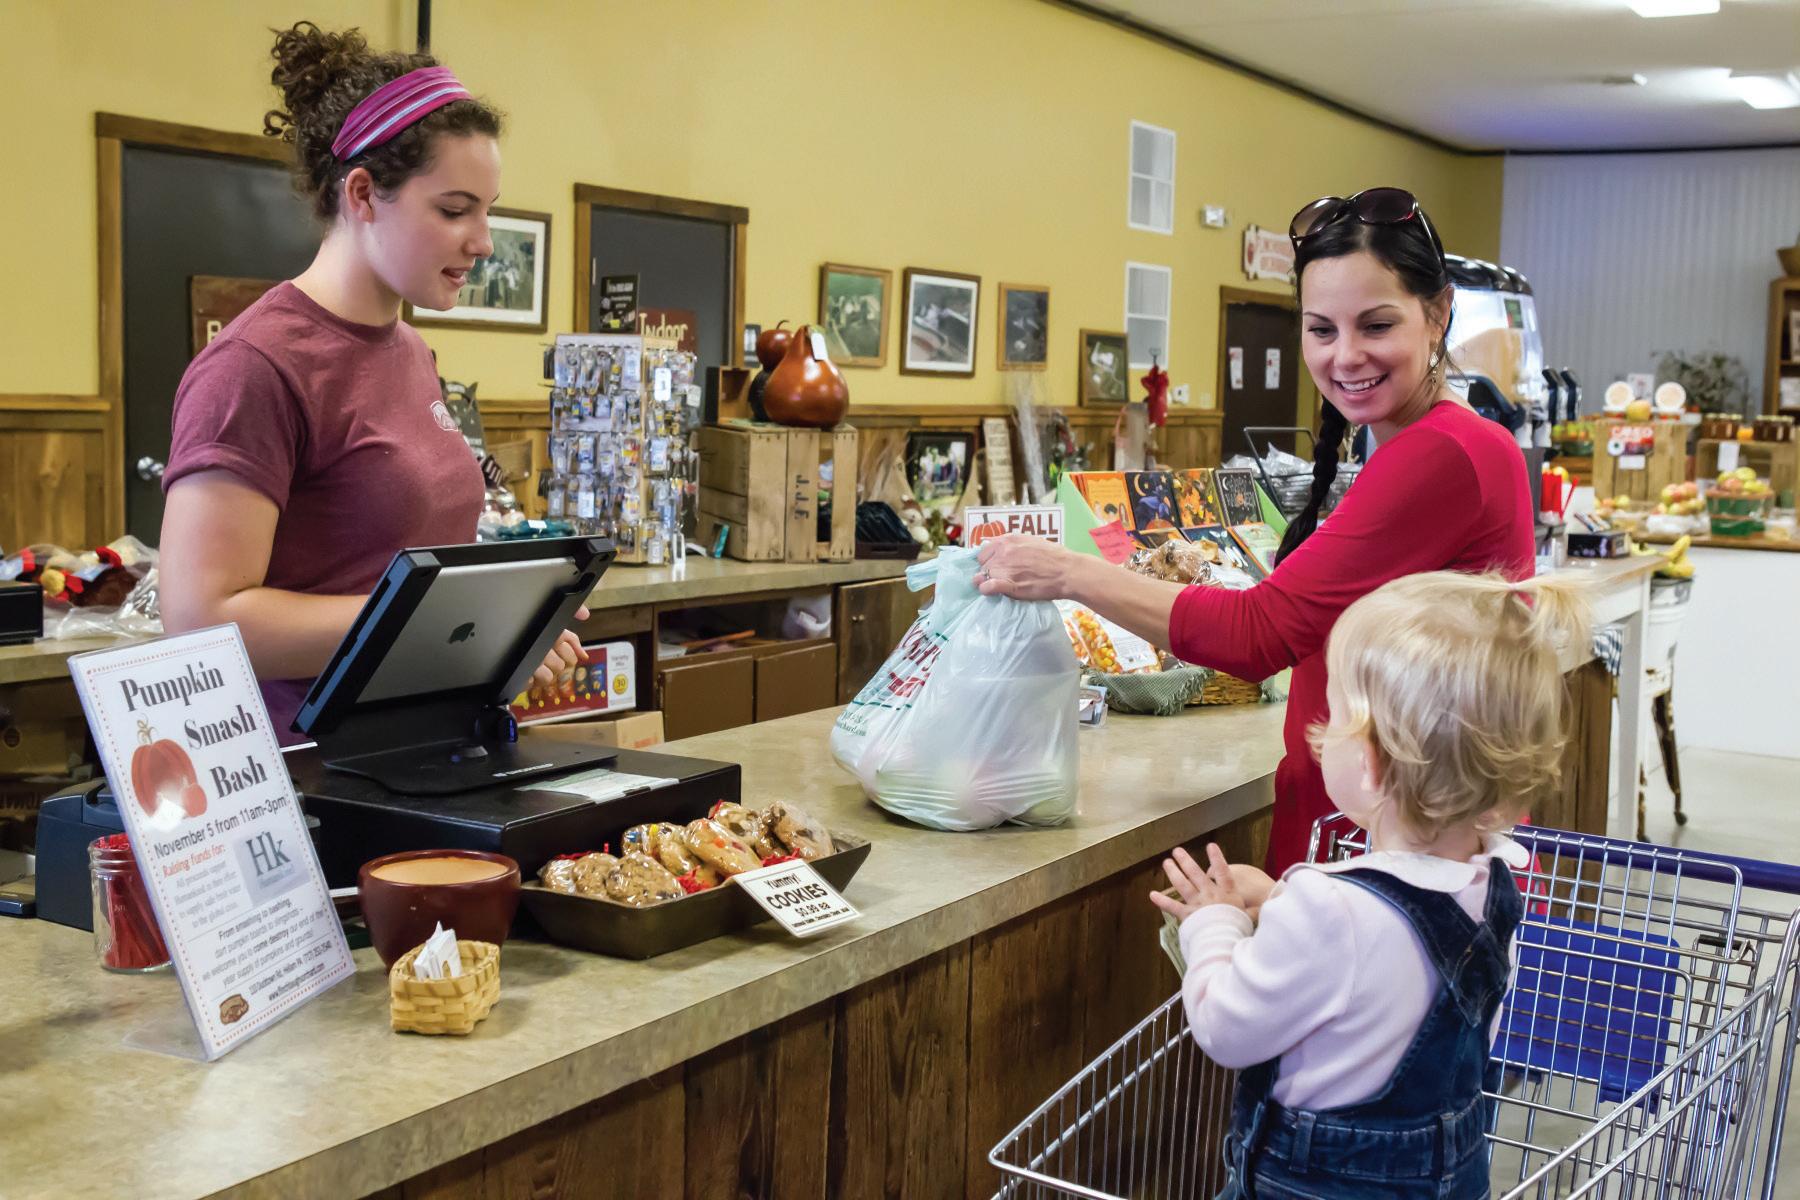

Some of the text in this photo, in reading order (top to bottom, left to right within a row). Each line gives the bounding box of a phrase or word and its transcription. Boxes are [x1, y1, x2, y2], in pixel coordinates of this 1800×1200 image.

[639, 312, 688, 341] Indoor
[1007, 513, 1058, 536] FALL
[118, 661, 224, 712] Pumpkin
[183, 704, 257, 750] Smash
[209, 755, 268, 798] Bash
[154, 796, 286, 857] November 5 from 11am-3pm
[190, 848, 211, 865] funds
[766, 883, 827, 908] COOKIES
